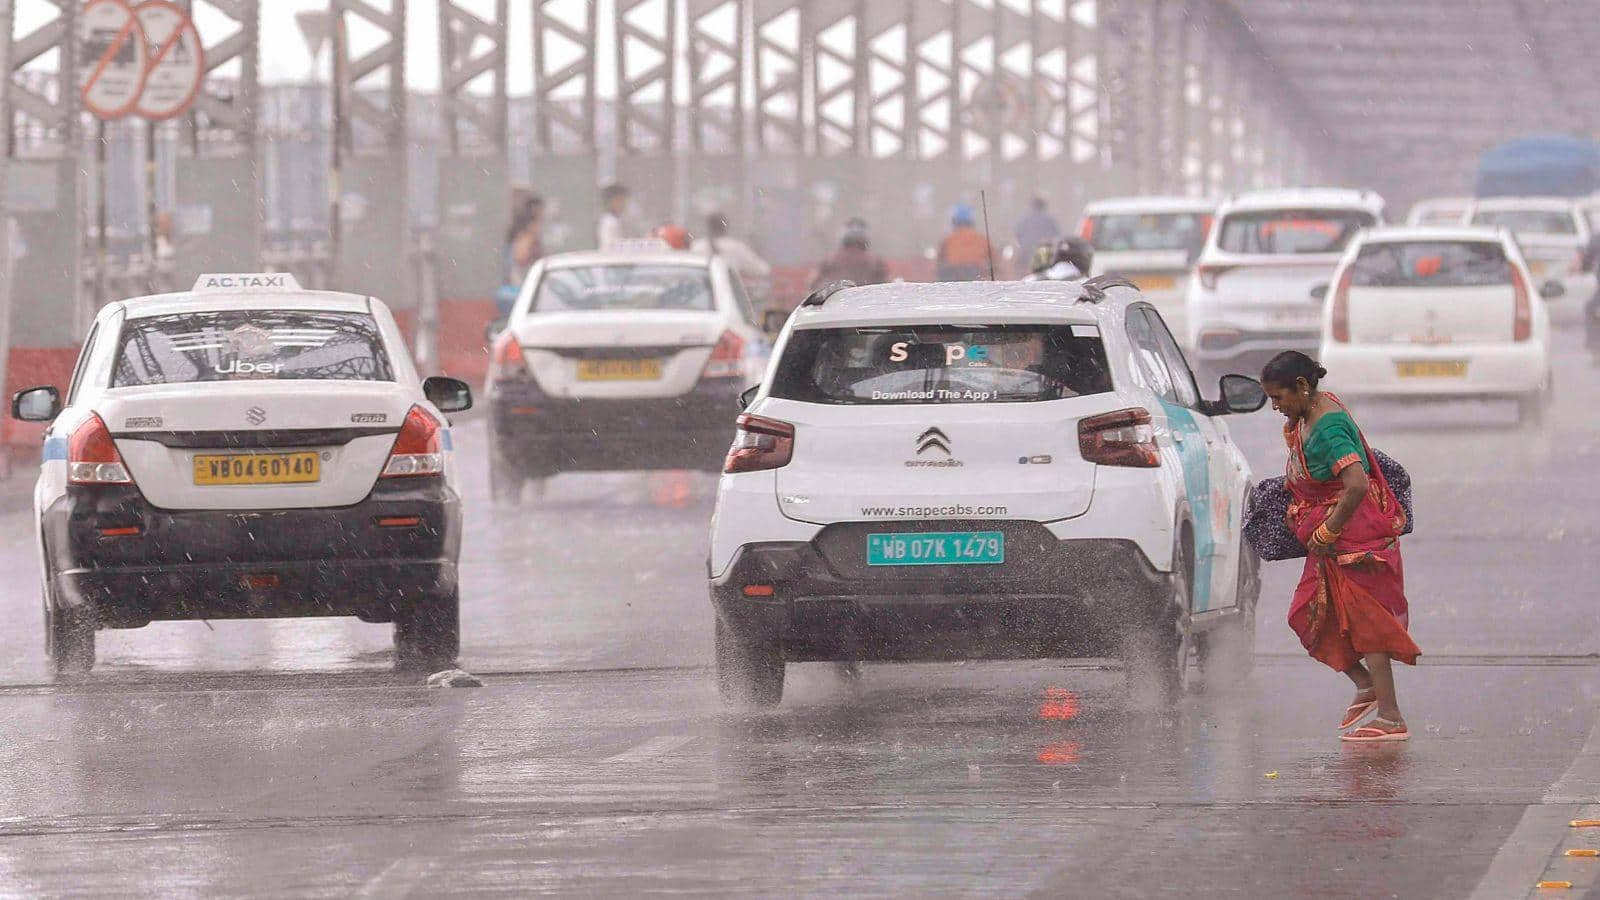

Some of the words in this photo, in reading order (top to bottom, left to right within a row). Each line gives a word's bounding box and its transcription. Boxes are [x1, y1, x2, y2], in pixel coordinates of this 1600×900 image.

[214, 359, 285, 374] Uber
[871, 389, 934, 400] Download
[936, 389, 961, 399] The
[963, 389, 990, 401] App
[861, 503, 1008, 518] www.snapecabs.com
[883, 538, 906, 559] WB
[911, 538, 946, 559] 07K
[953, 537, 999, 558] 1479
